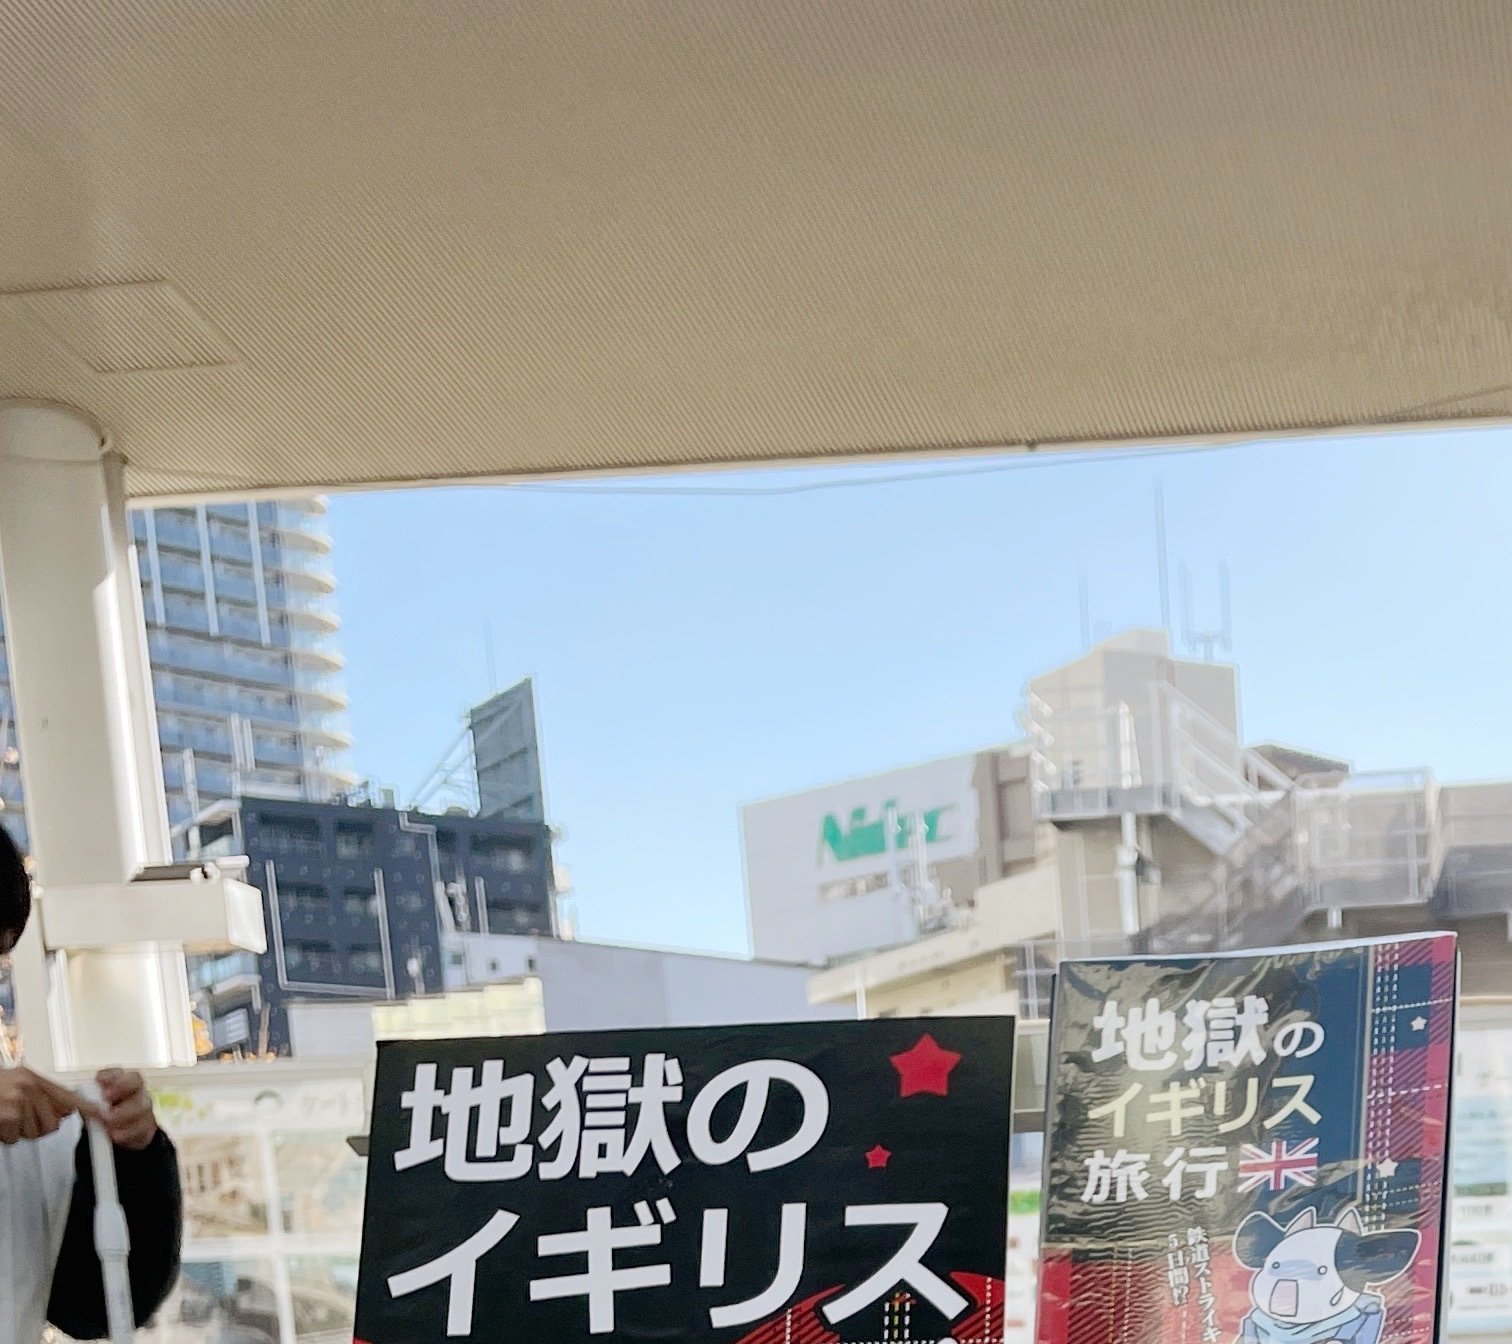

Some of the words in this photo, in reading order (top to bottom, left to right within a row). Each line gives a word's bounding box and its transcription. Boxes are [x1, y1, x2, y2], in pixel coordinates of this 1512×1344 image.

[1091, 995, 1325, 1073] 地獄の
[393, 1051, 830, 1183] 地獄の
[1087, 1073, 1323, 1139] イギリス
[1080, 1147, 1229, 1204] 旅行
[386, 1197, 970, 1337] イギリス
